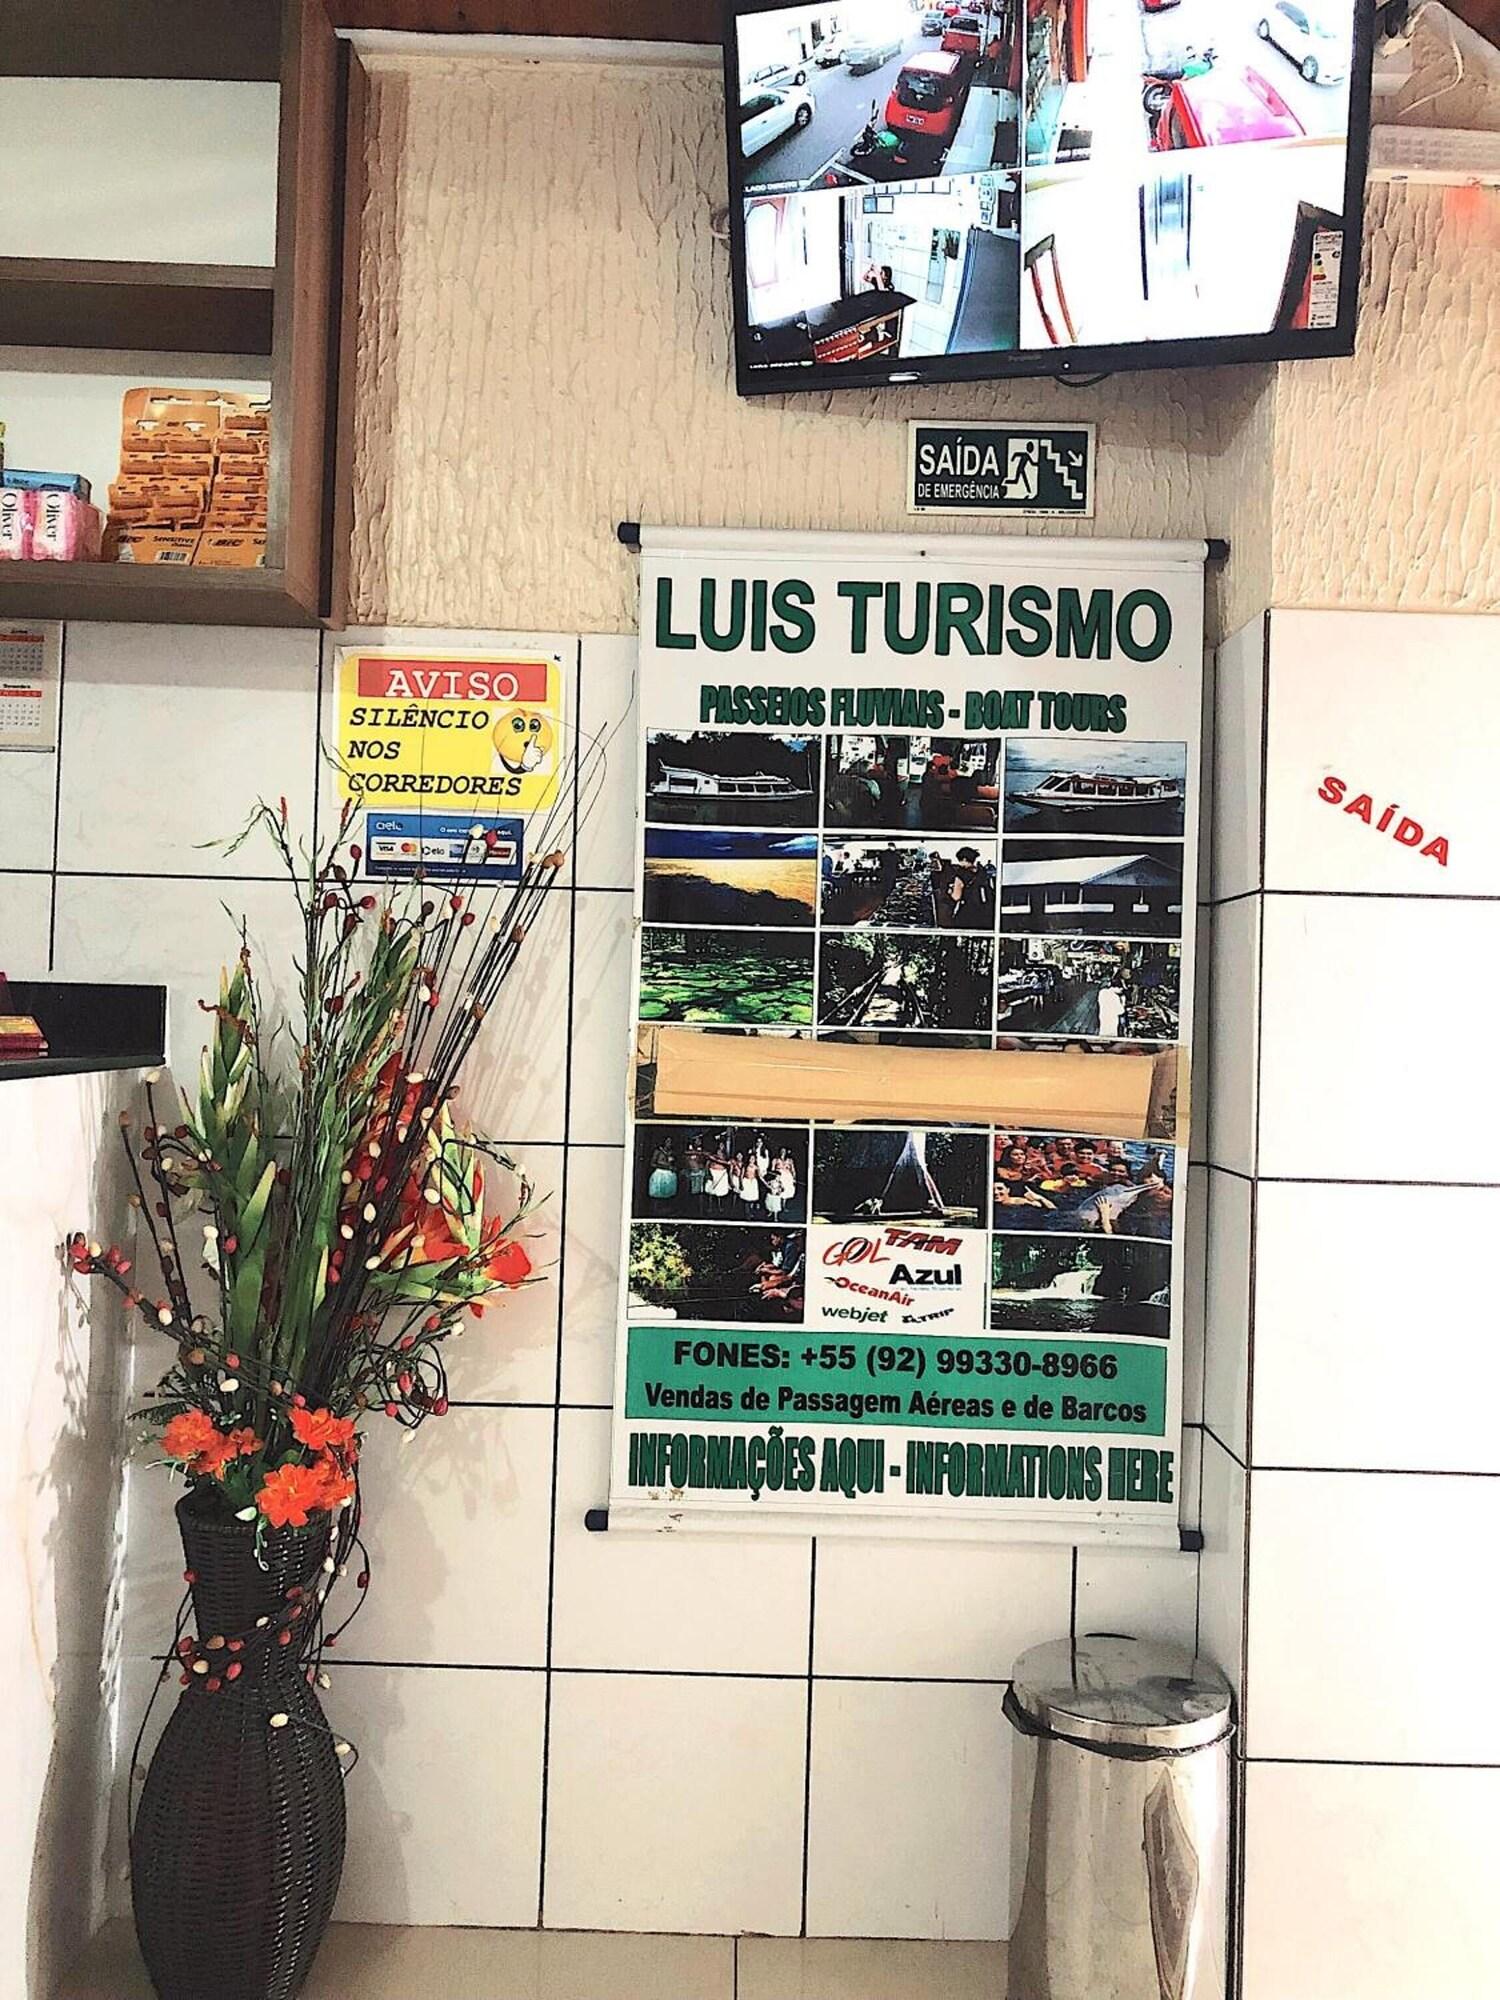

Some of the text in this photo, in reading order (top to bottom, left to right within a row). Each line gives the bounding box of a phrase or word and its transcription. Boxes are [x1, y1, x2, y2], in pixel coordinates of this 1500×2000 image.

[919, 437, 1000, 476] SAÍDA
[917, 481, 1000, 499] DE EMERGÊNCIA
[212, 538, 244, 547] BIC
[655, 577, 1173, 663] LUIS TURISMO
[385, 670, 520, 701] AVISO
[349, 704, 490, 729] SILÊNCIO
[699, 685, 1127, 734] PASSEIOS FLUVIAIS - BOAT TOURS
[347, 741, 401, 760] NOS
[347, 773, 522, 796] CORREDORES
[1317, 776, 1449, 867] SAÍDA
[822, 1237, 891, 1266] GOL
[884, 1227, 964, 1256] TAM
[889, 1264, 963, 1286] Azul
[834, 1277, 916, 1307] OceanAir
[822, 1306, 889, 1324] webjet
[674, 1341, 1118, 1381] FONES: +55 (92) 99330-8966
[645, 1383, 1148, 1423] Vendas de Passagem Aéreas e de Barcos
[628, 1426, 1174, 1504] INFORMAÇÕES AQUI - INFORMATIONS HERE
